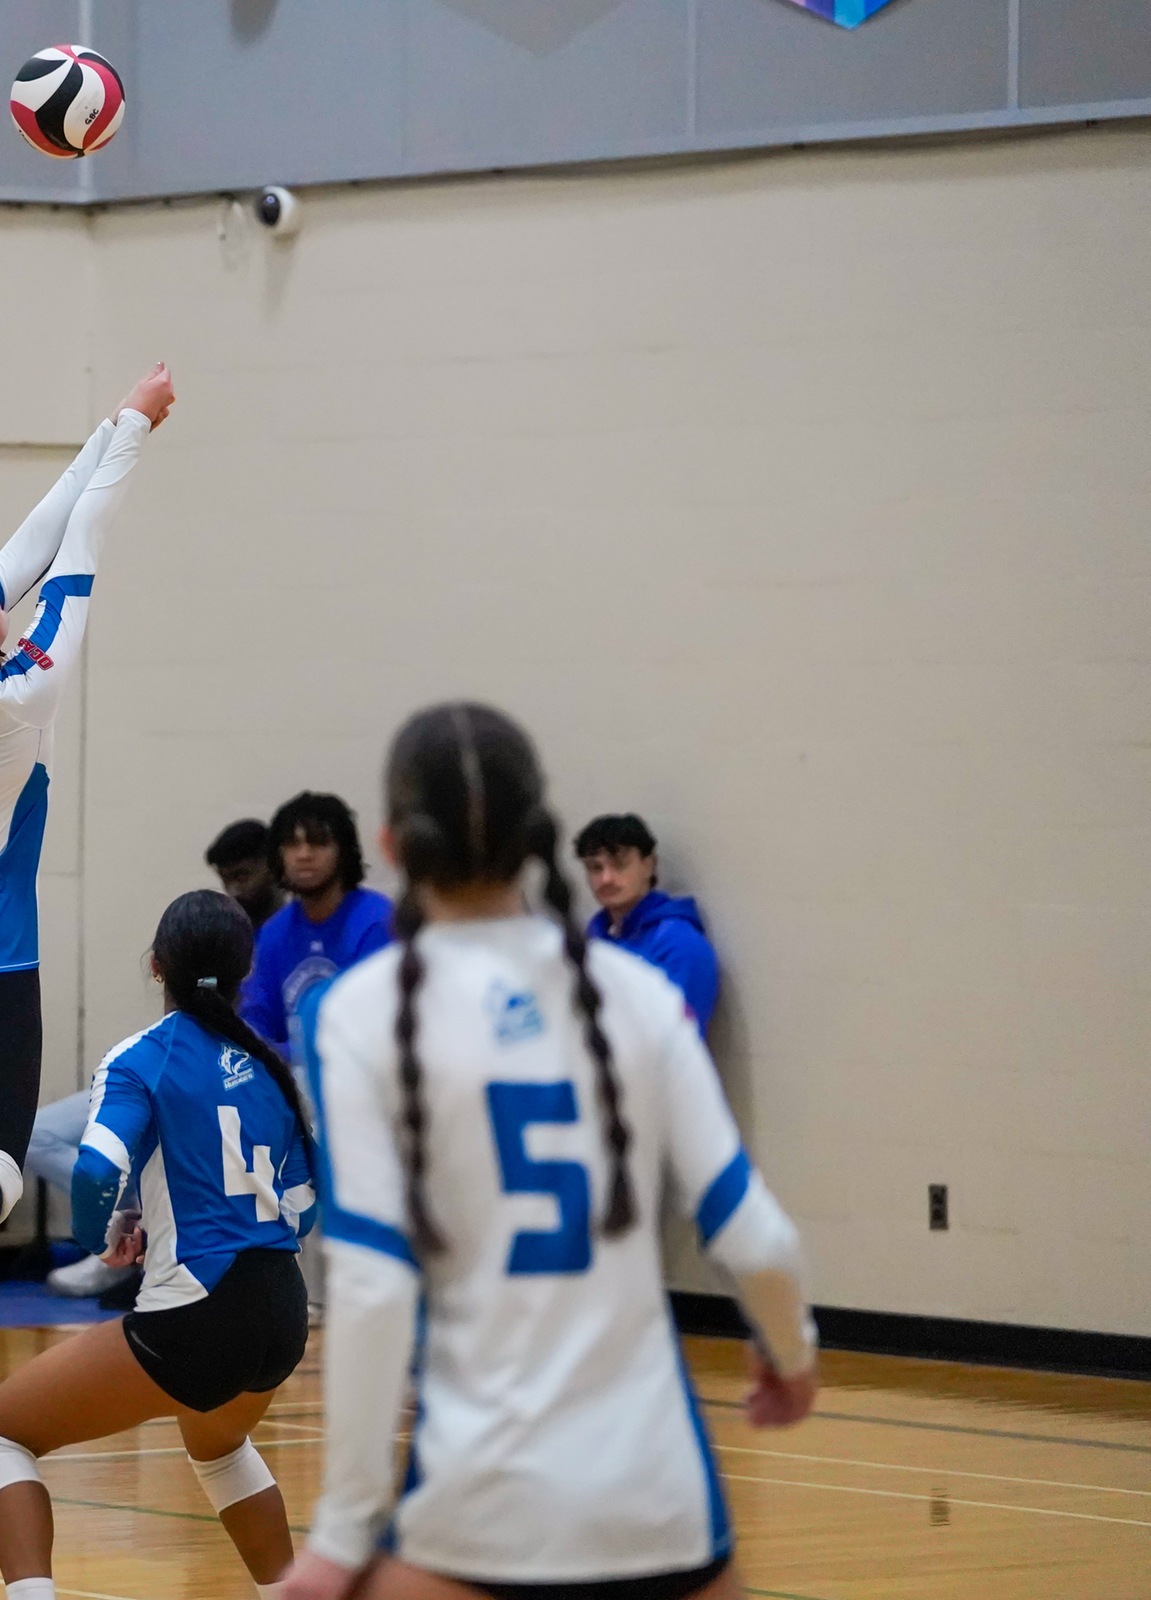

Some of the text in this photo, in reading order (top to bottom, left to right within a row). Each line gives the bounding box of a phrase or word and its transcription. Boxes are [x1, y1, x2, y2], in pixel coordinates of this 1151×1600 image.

[84, 108, 99, 125] GBC
[217, 1105, 280, 1223] 4
[486, 1082, 590, 1275] 5
